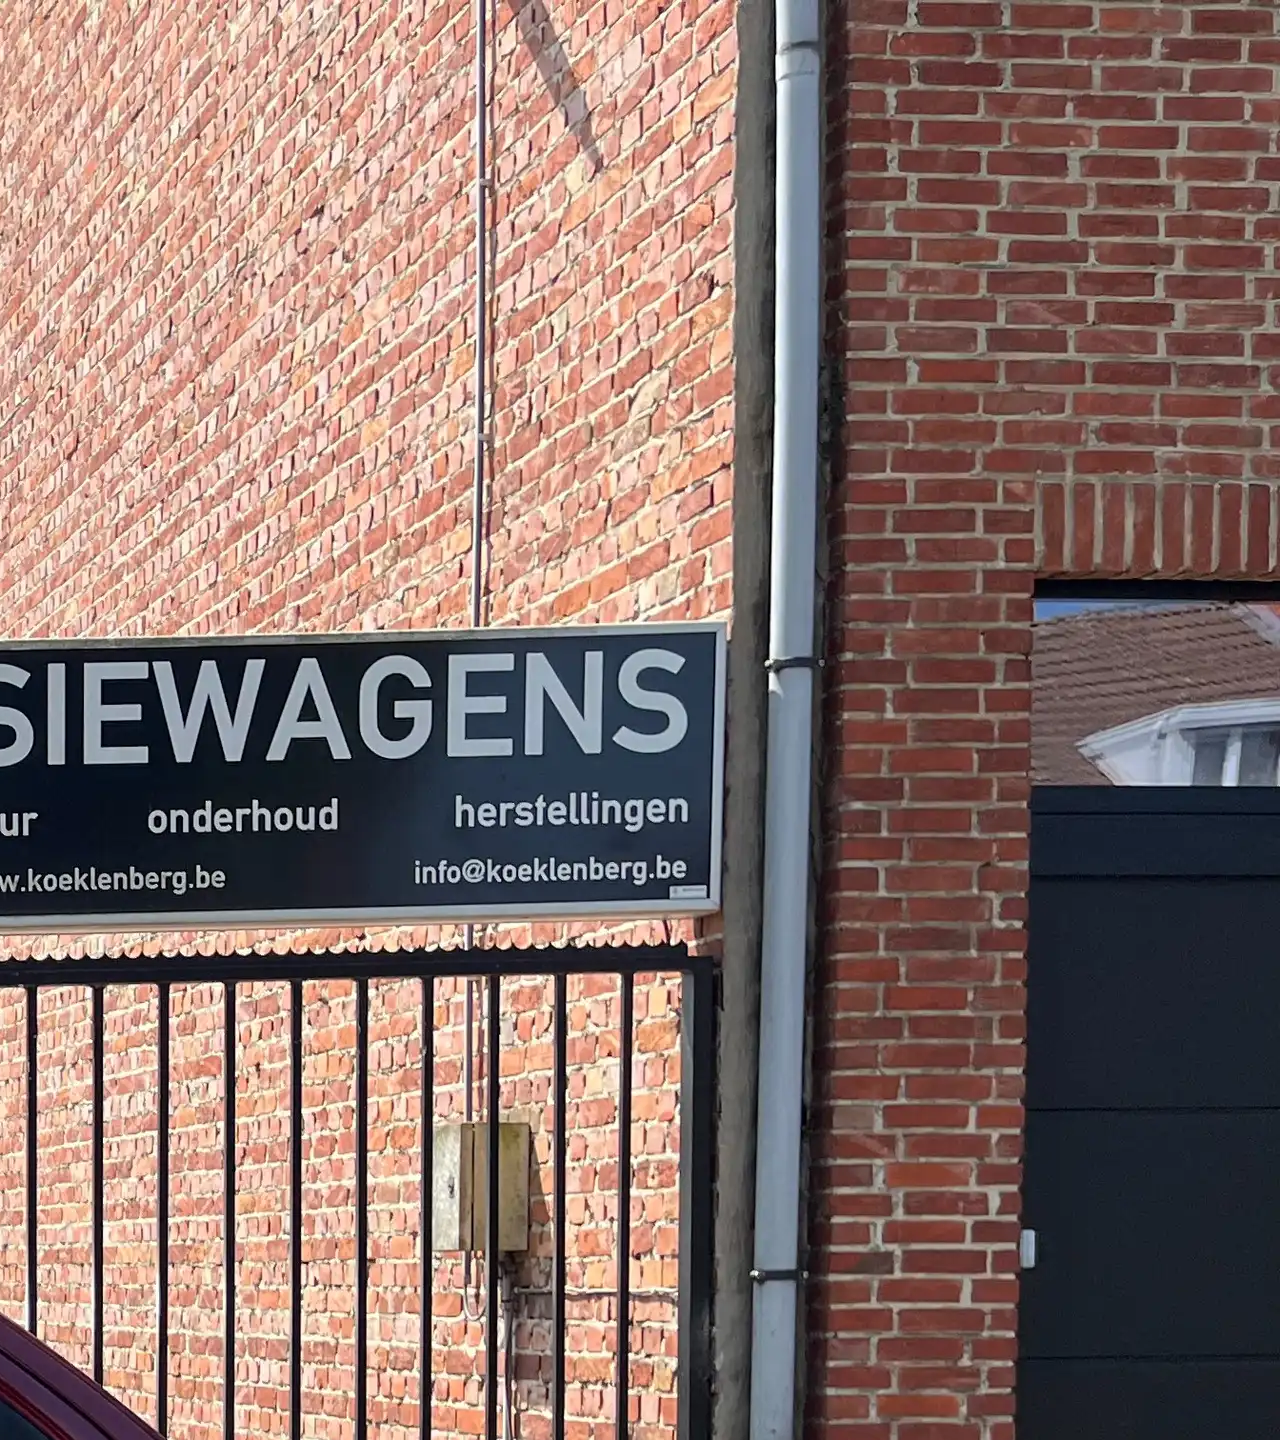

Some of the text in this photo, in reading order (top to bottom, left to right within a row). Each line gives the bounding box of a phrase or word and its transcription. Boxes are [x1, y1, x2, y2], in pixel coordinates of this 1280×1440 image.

[147, 797, 339, 834] onderhoud
[454, 791, 689, 833] herstellingen
[413, 856, 688, 885] info@koeklenberg.be
